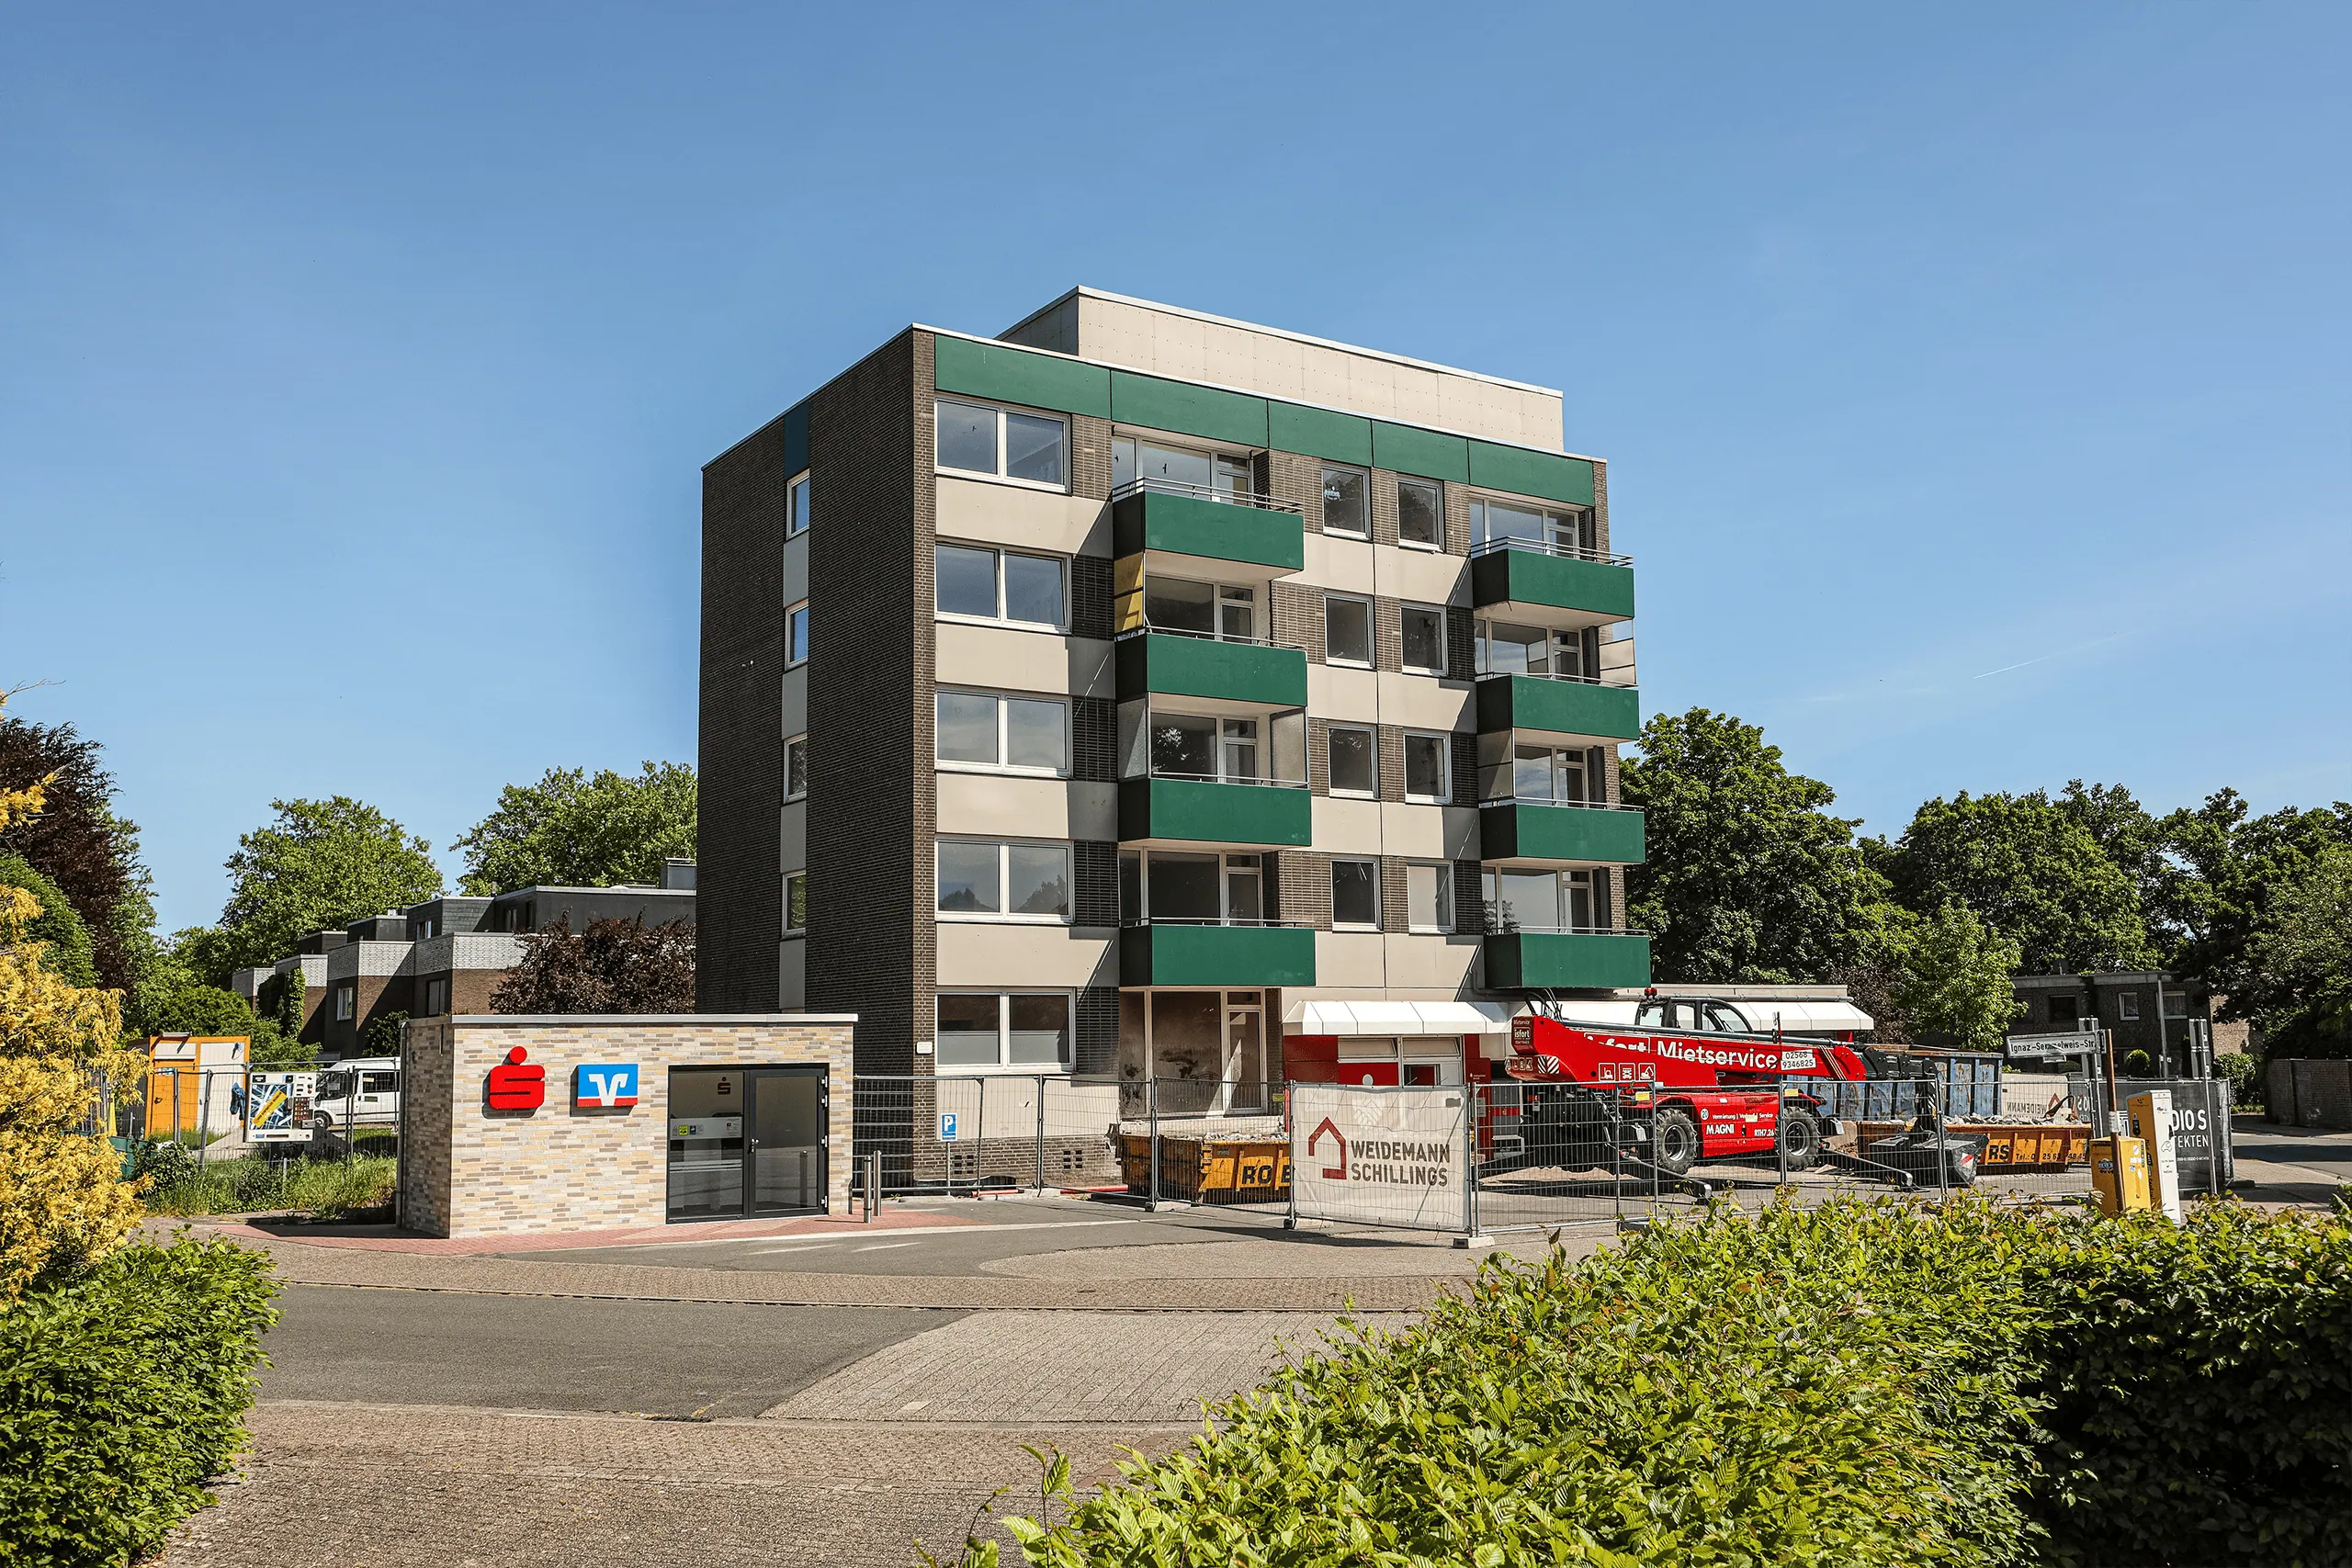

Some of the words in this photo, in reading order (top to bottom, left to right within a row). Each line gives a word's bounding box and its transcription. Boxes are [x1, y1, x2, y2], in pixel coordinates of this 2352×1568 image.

[1514, 1029, 1530, 1038] isfort
[1657, 1040, 1778, 1069] Mietservice
[1785, 1051, 1808, 1060] 02568
[1782, 1060, 1814, 1069] 9346825
[944, 1115, 954, 1132] P
[1706, 1123, 1735, 1134] MAGNI
[2197, 1109, 2207, 1131] S
[1351, 1140, 1450, 1163] WEIDEMANN
[1351, 1162, 1448, 1187] SCHILLINGS
